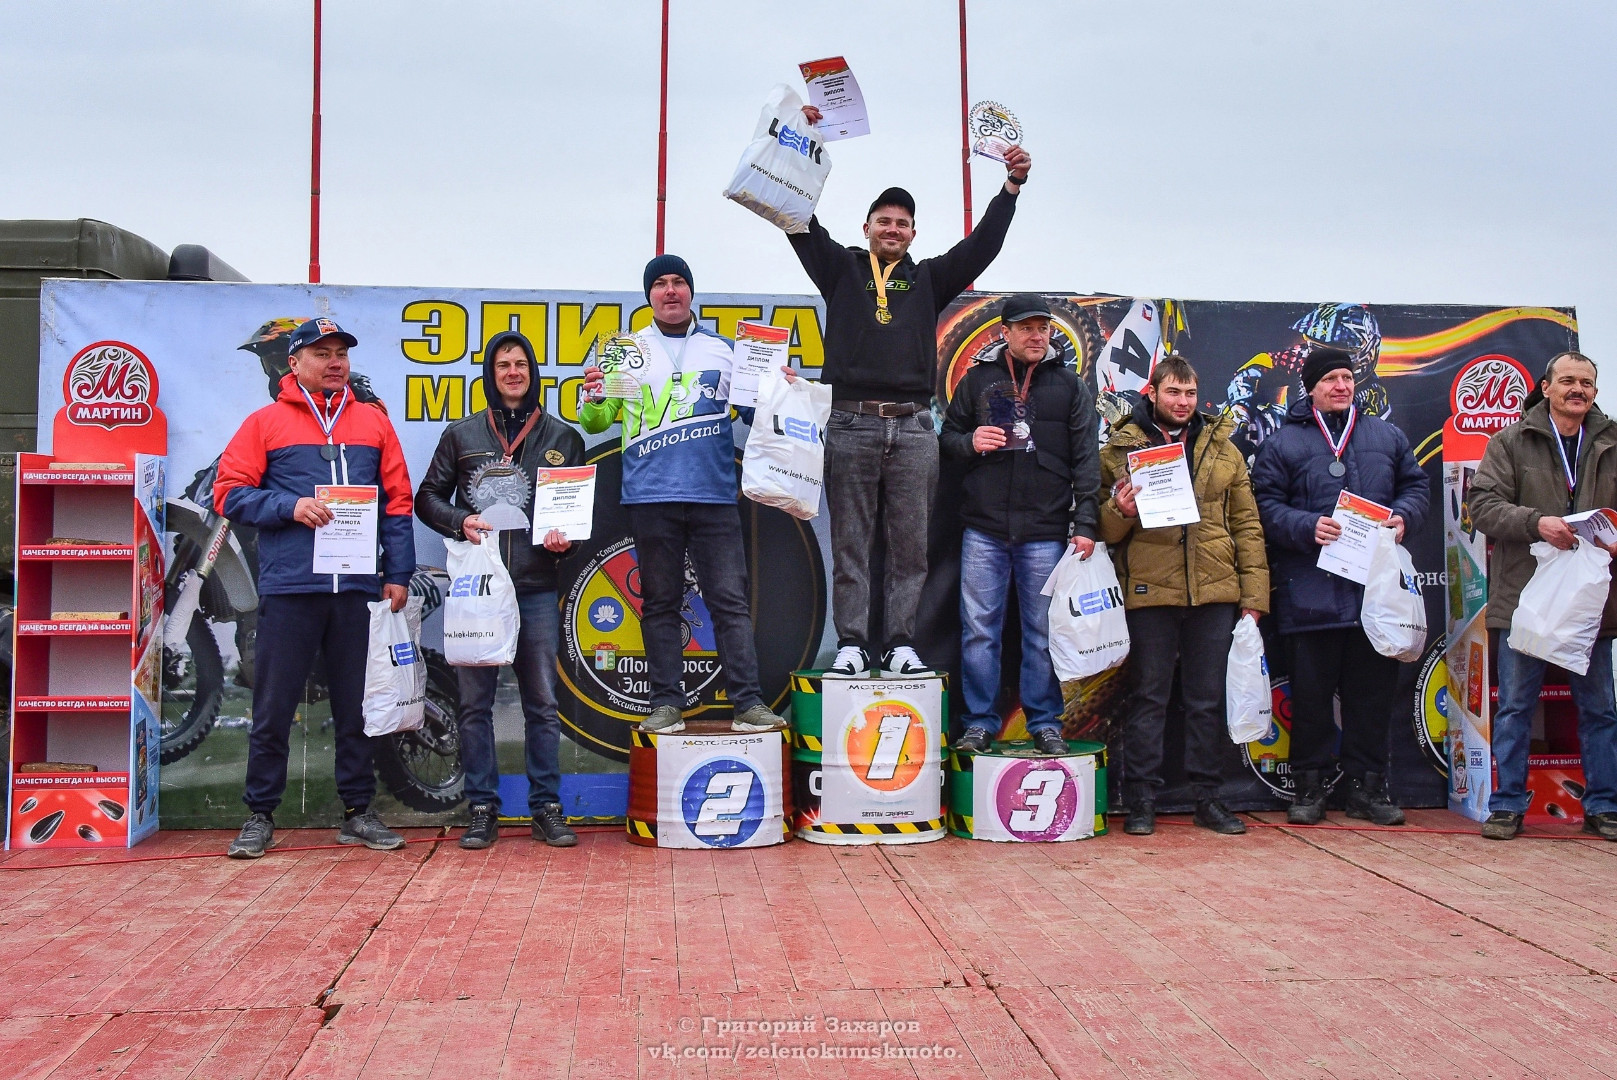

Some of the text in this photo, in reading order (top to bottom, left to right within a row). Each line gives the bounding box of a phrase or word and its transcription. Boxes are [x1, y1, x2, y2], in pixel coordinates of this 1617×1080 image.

[768, 117, 823, 165] LEEK
[750, 162, 813, 201] www.leek-lamp.ru
[1109, 328, 1152, 380] 4
[76, 407, 142, 419] МАРТИН
[638, 422, 721, 458] MotoLand
[62, 473, 90, 481] ВСЕГДА
[1148, 478, 1172, 487] ДИПЛОМ
[1344, 526, 1367, 539] ГРАМОТА
[61, 549, 88, 557] ВСЕГДА
[59, 624, 87, 632] ВСЕГДА
[57, 701, 85, 709] ВСЕГДА
[682, 737, 764, 746] MOTOCROSS
[865, 715, 912, 781] 1
[694, 771, 754, 836] 2
[1008, 769, 1066, 832] 3
